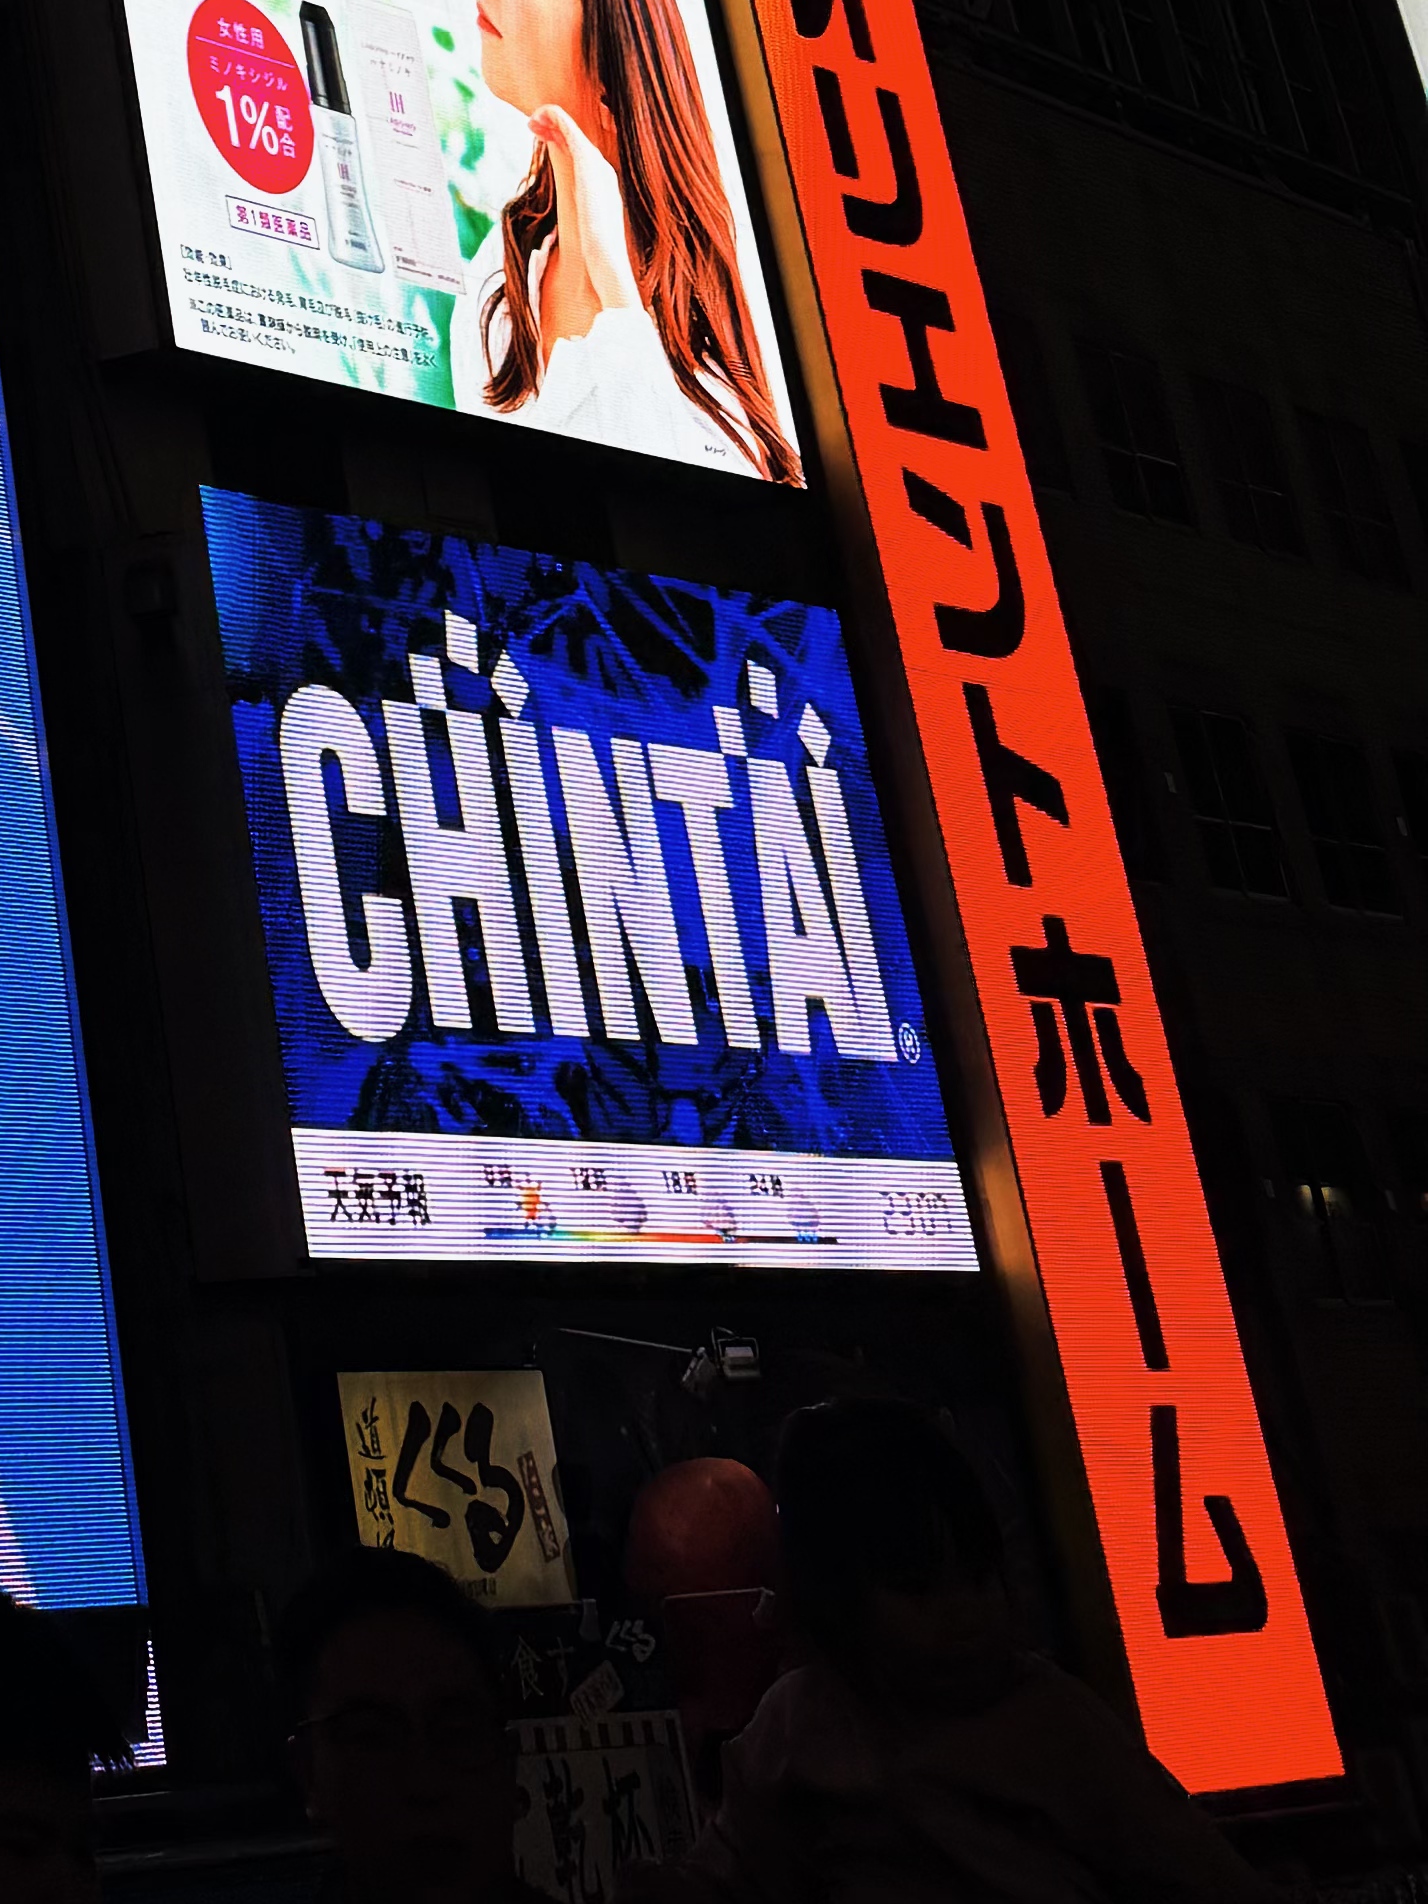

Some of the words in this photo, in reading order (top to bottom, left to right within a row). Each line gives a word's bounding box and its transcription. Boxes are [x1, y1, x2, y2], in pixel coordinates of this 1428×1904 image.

[216, 17, 265, 50] 女性用
[215, 84, 280, 156] 1%
[280, 682, 900, 1064] CHINTAI
[323, 1166, 432, 1226] 天気予報
